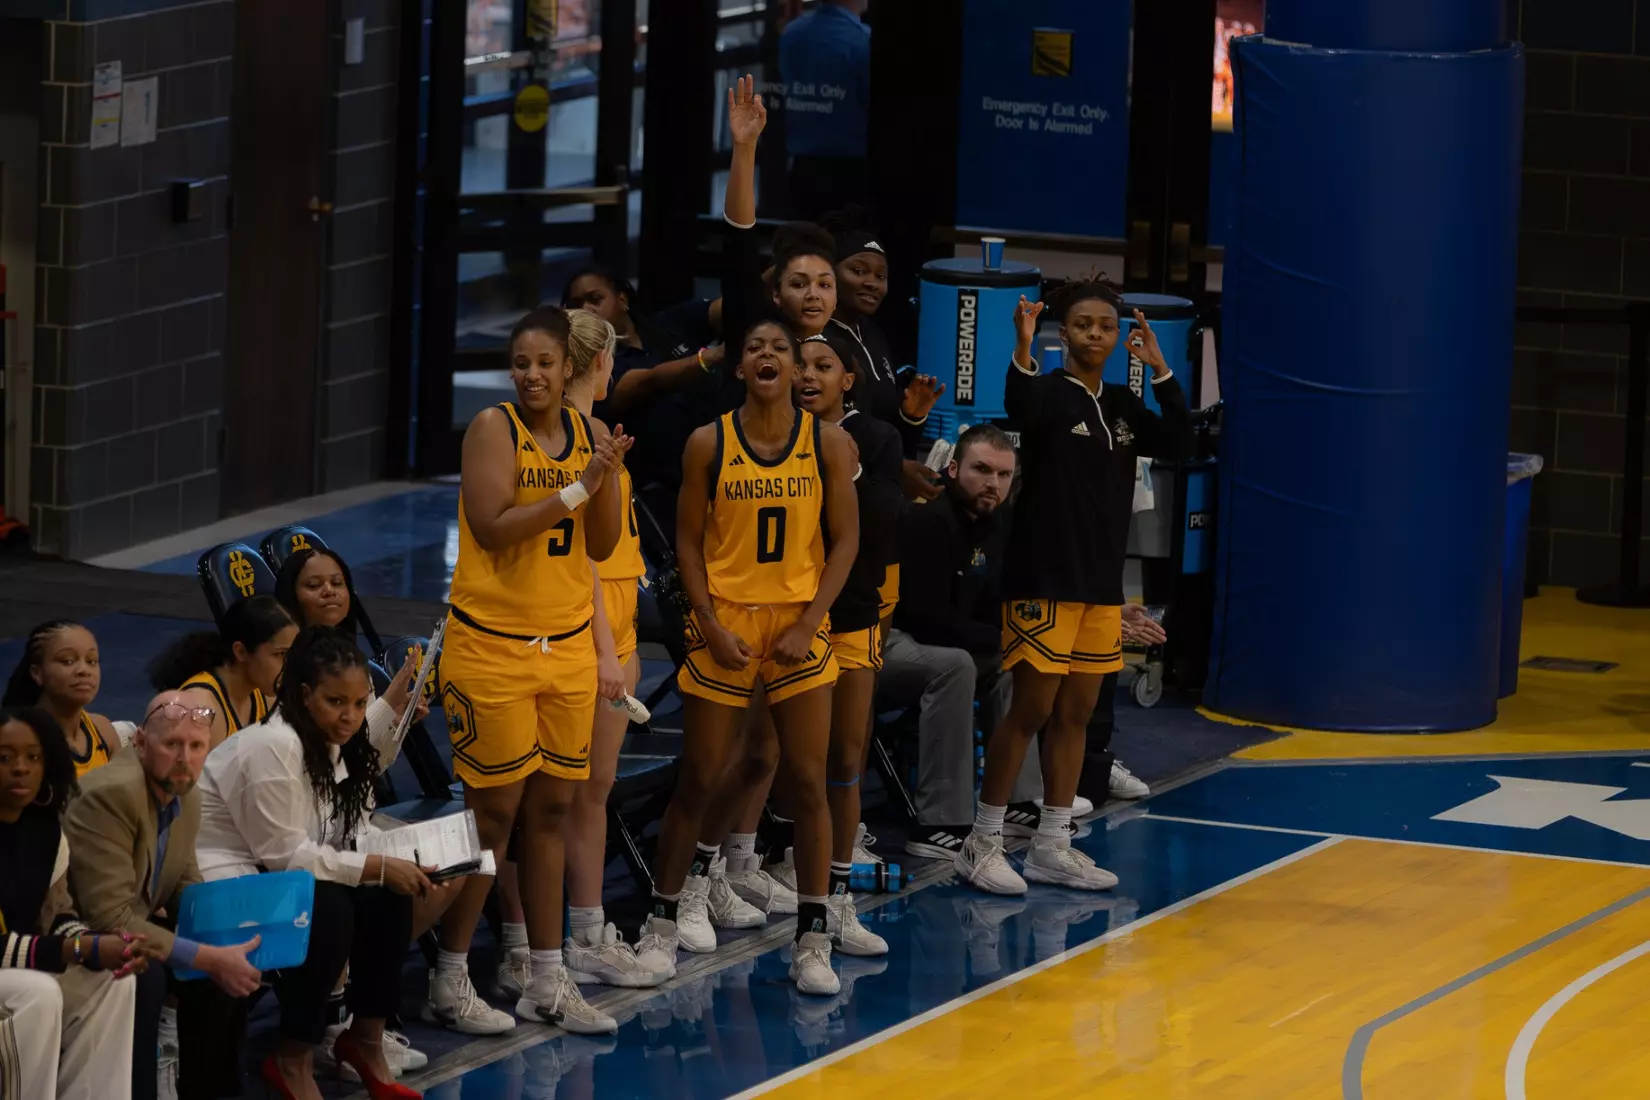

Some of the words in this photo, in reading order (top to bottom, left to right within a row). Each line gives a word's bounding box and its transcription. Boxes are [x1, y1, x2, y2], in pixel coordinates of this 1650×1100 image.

[793, 81, 816, 97] Exit
[820, 84, 847, 101] Only
[785, 97, 834, 115] Alarmed
[982, 95, 1048, 117] Emergency
[1052, 101, 1076, 118] Exit
[994, 113, 1025, 130] Door
[1028, 116, 1040, 132] Is
[1044, 118, 1094, 136] Alarmed
[956, 294, 977, 401] POWERADE
[517, 466, 573, 489] KANSAS
[724, 477, 783, 501] KANSAS
[787, 476, 815, 498] CITY
[757, 506, 787, 564] 0
